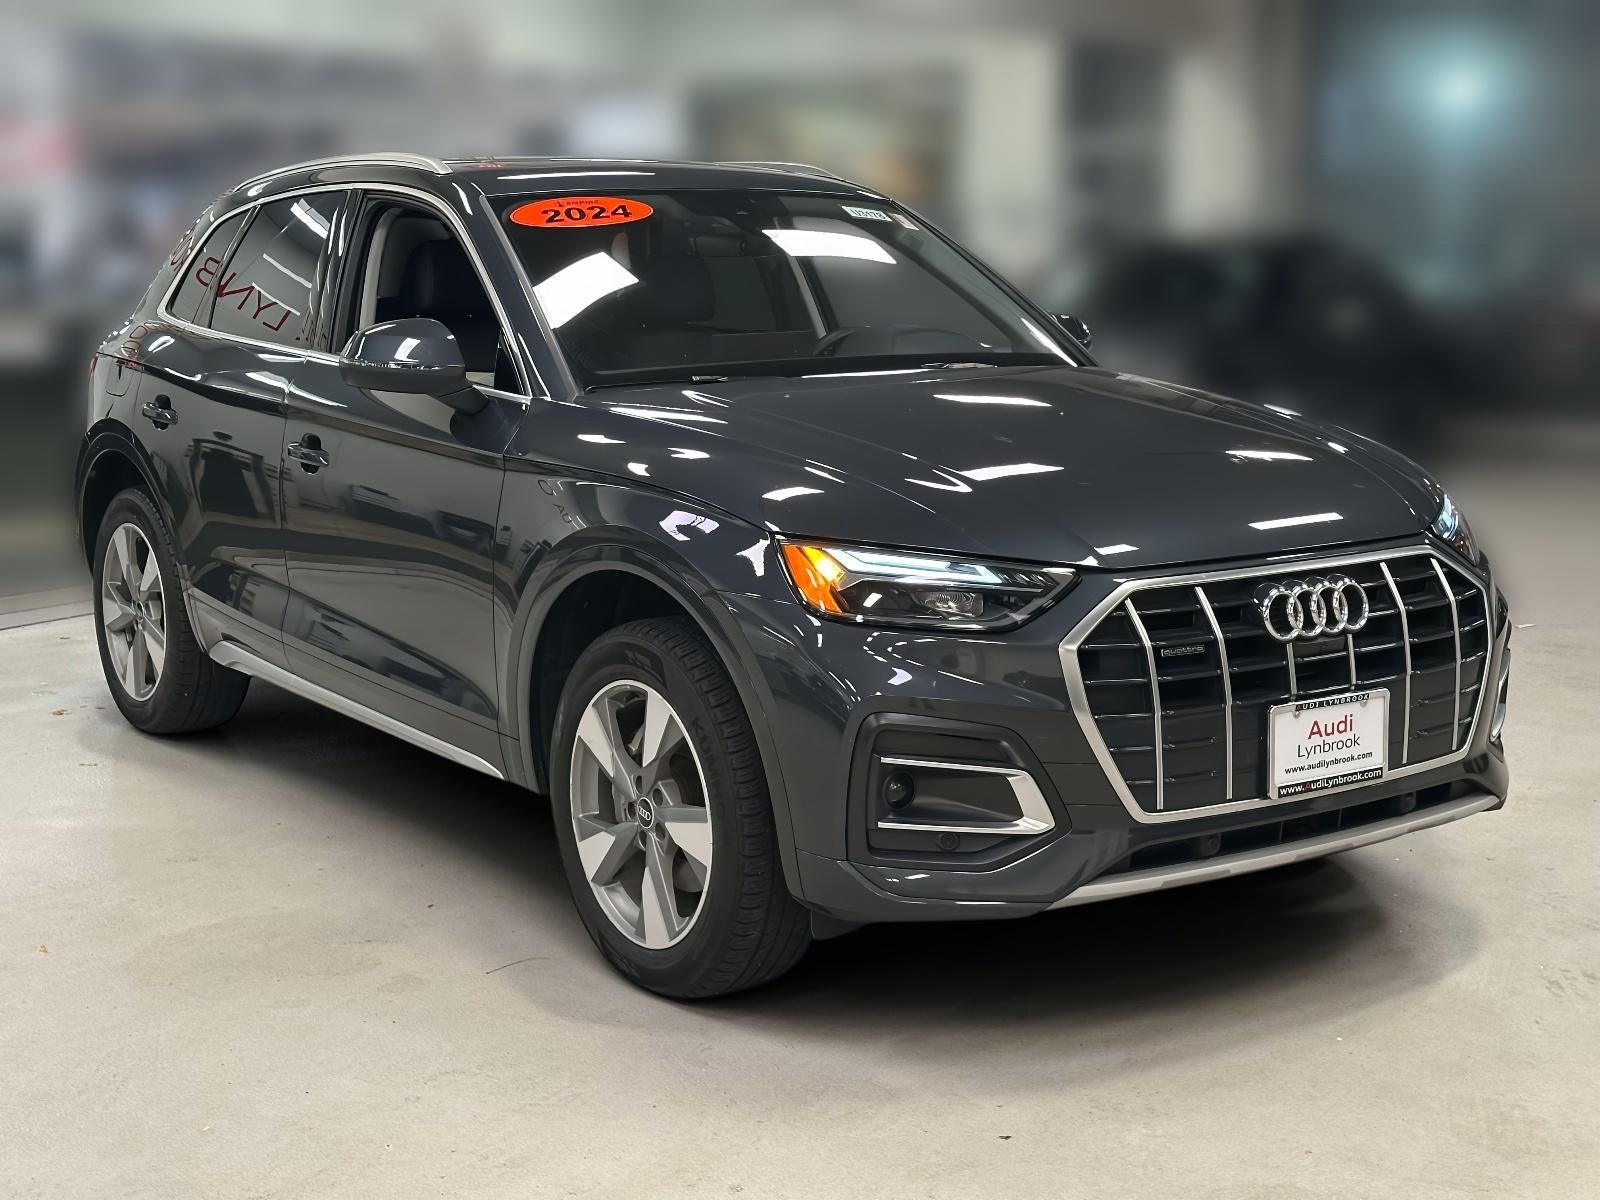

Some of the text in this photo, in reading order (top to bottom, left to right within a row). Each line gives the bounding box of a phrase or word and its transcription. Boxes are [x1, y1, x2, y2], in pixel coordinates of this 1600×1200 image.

[541, 204, 633, 224] 2024
[1163, 645, 1204, 656] quattro
[1296, 693, 1370, 712] AUDI LYNBROOK
[1307, 714, 1354, 740] Audi
[1297, 733, 1361, 759] Lynbrook
[1284, 751, 1373, 775] www.audilynbrook.com
[1279, 769, 1382, 795] www.AudiLynbrook.com
